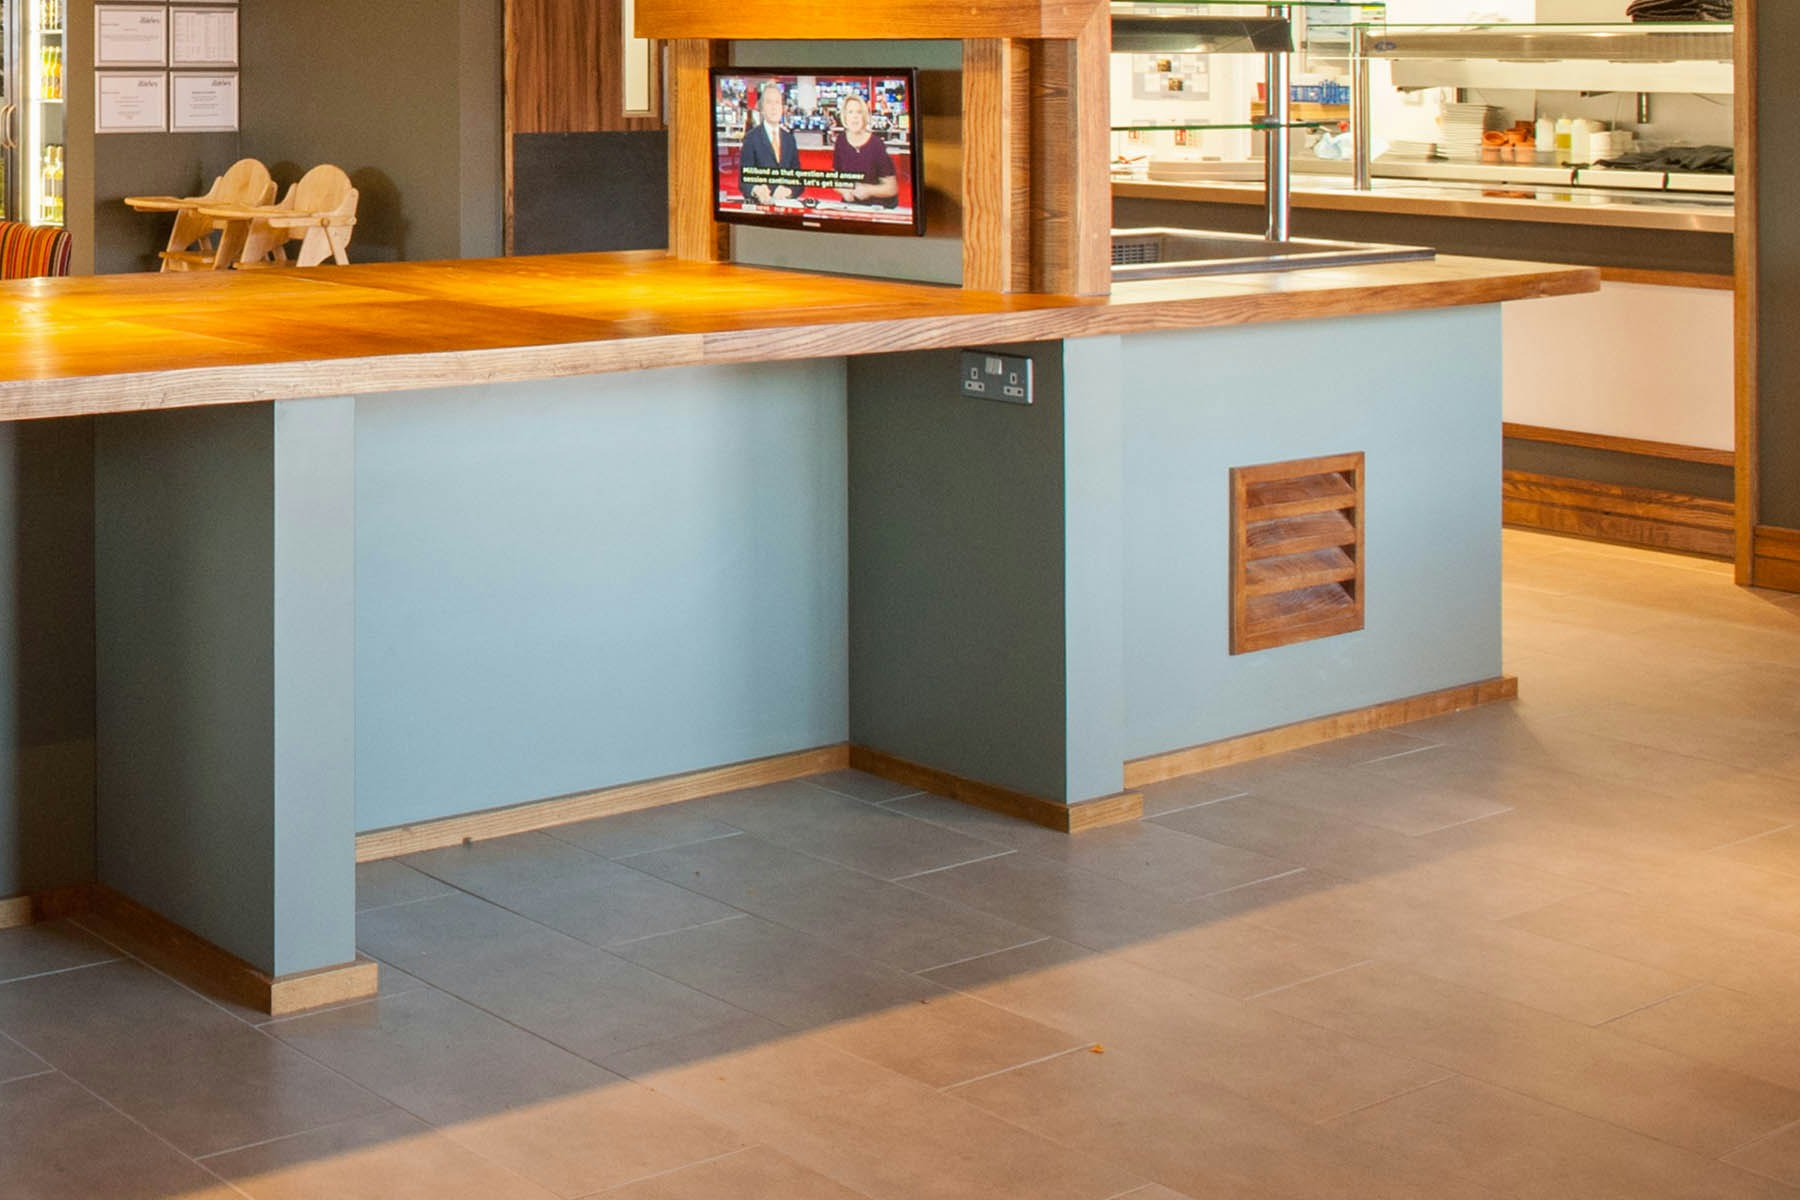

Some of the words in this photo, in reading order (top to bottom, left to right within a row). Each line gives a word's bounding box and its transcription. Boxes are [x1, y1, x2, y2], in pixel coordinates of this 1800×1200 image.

[780, 168, 794, 177] that
[795, 170, 825, 179] question
[825, 171, 839, 179] and
[803, 178, 820, 187] Let's
[821, 180, 833, 188] get
